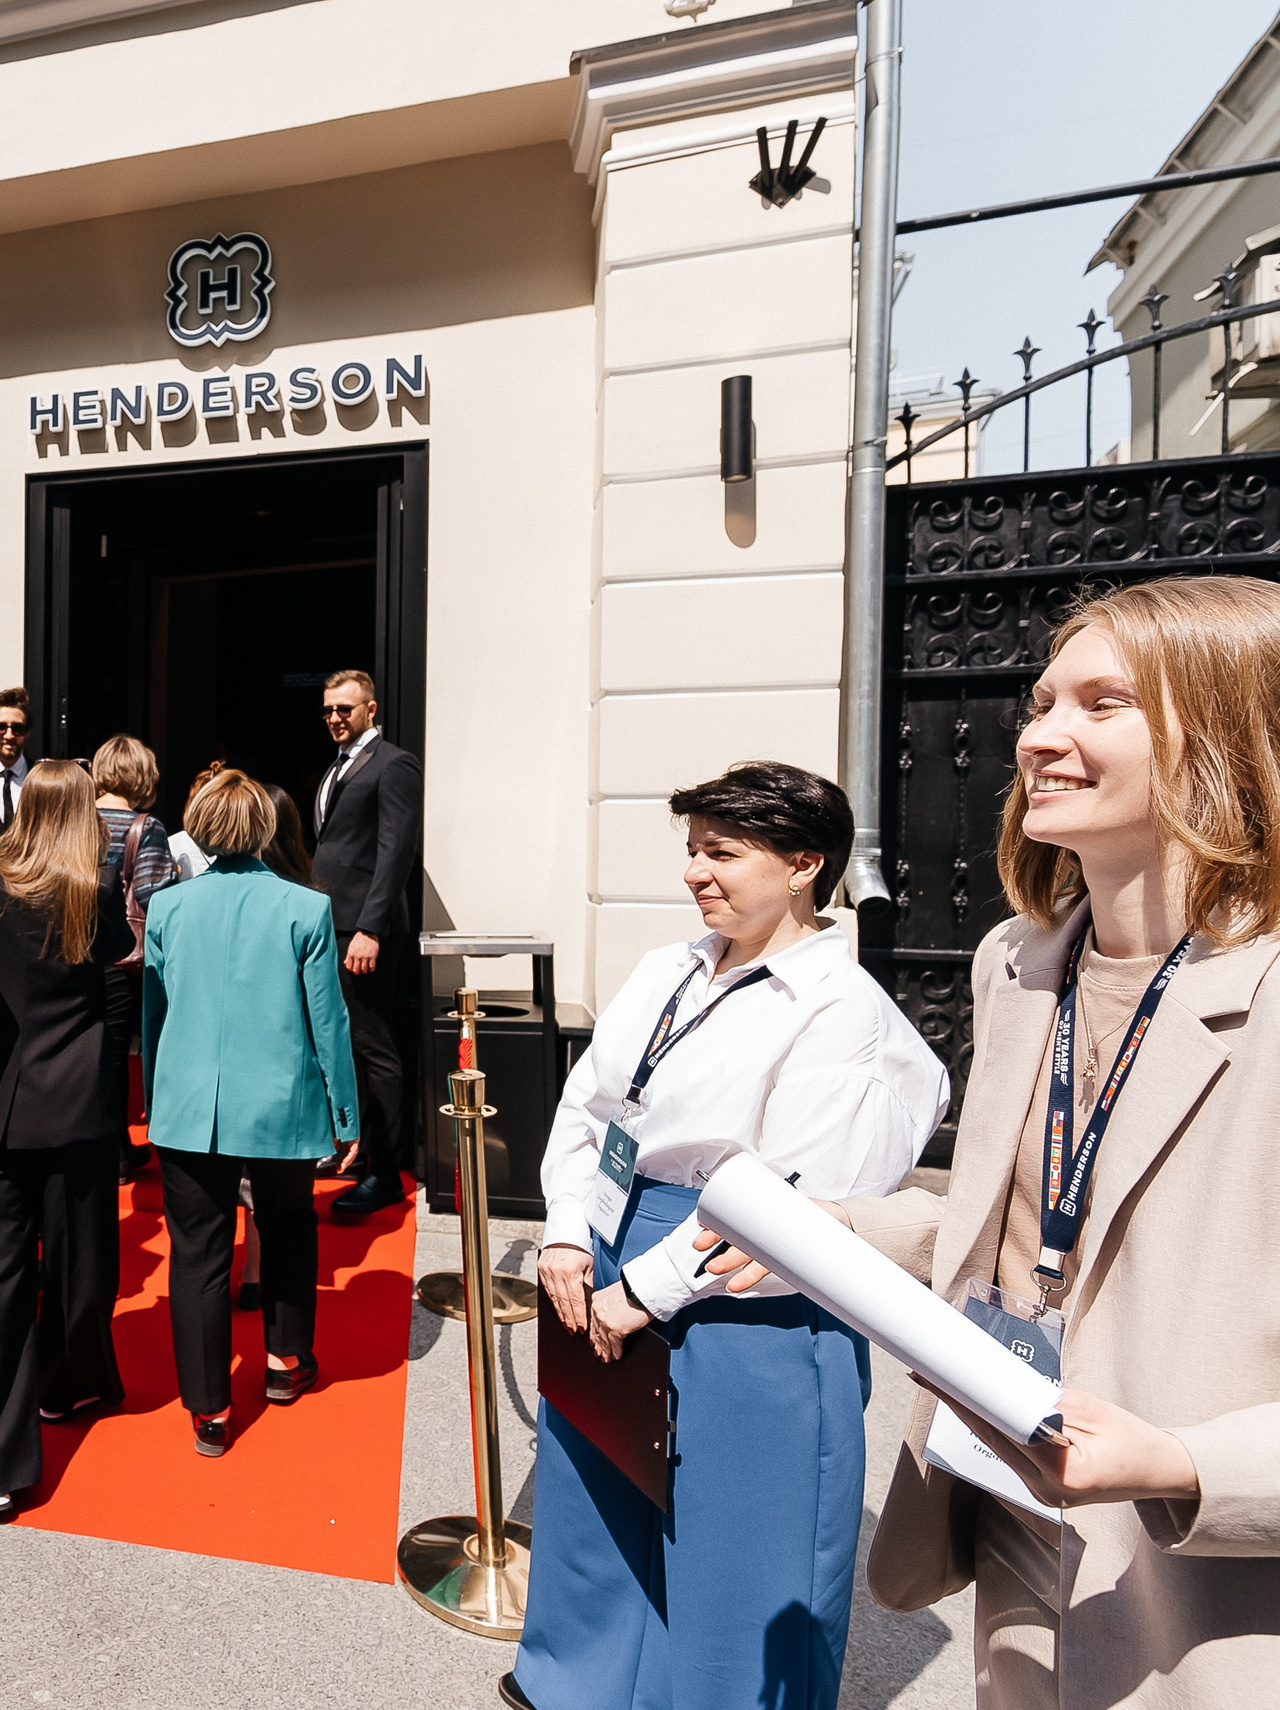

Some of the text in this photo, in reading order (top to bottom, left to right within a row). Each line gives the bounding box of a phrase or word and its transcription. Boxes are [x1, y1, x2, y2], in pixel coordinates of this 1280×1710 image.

[197, 264, 240, 315] H
[29, 353, 428, 435] HENDERSON
[1161, 965, 1177, 979] 30
[1060, 1022, 1070, 1072] 30 YEARS
[1066, 1131, 1097, 1201] HENDERSON
